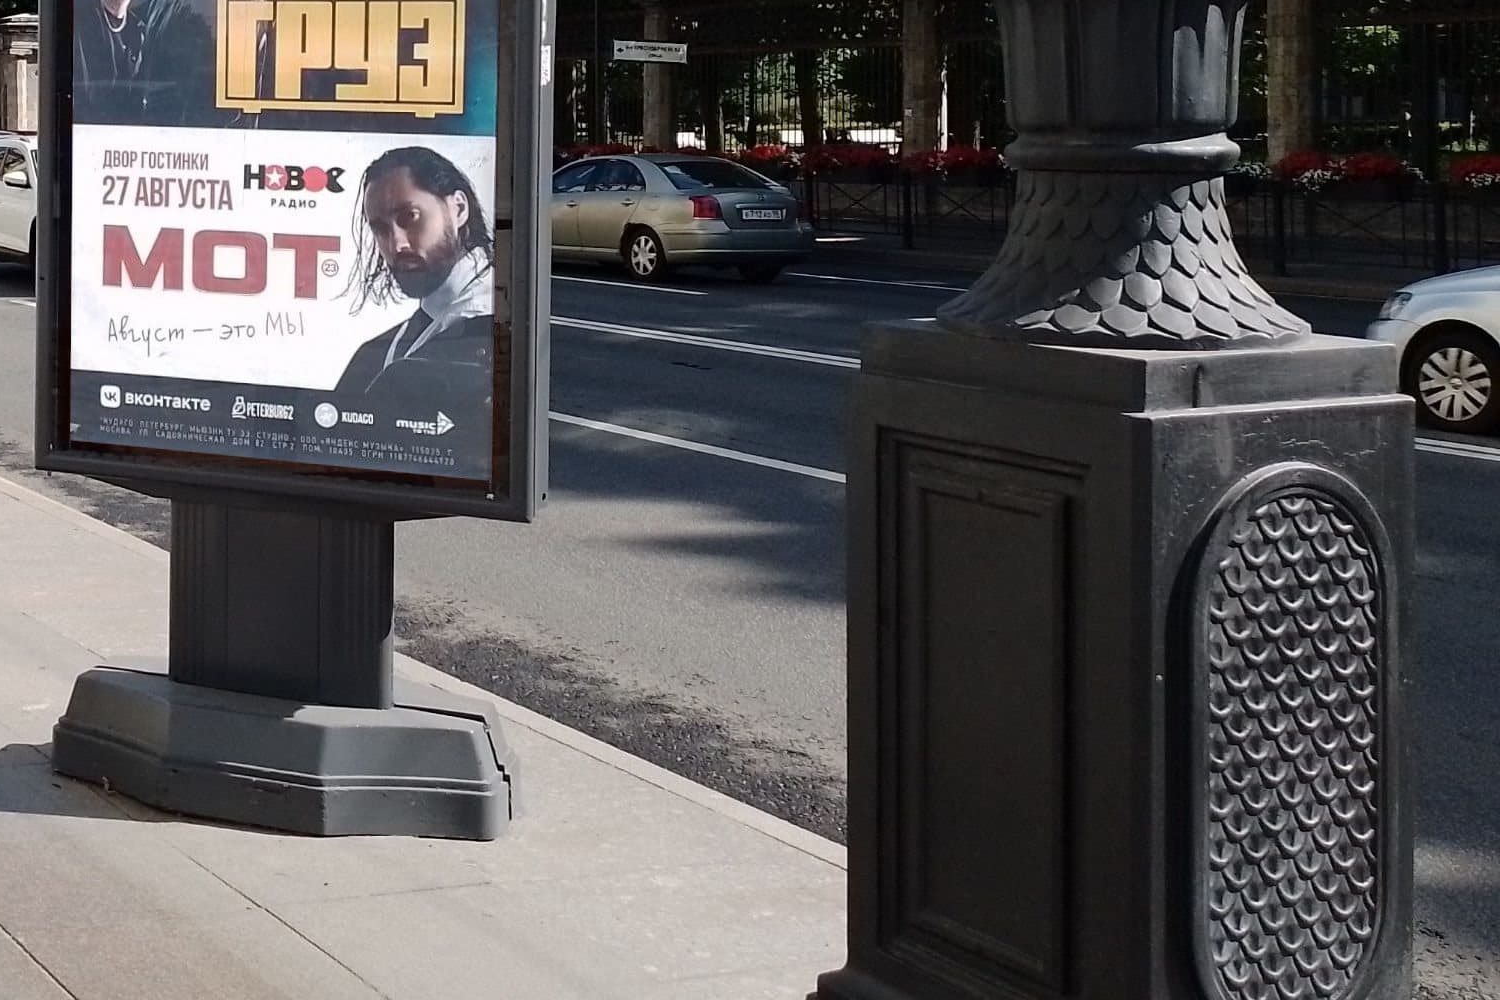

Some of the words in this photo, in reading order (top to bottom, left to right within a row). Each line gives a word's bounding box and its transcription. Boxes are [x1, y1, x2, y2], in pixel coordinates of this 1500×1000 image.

[226, 0, 456, 103] ГРУЗ
[103, 150, 137, 169] ДВОР
[141, 152, 209, 171] ГОСТИНКИ
[102, 175, 130, 206] 27
[134, 177, 233, 211] АВГУСТА
[270, 198, 317, 209] РАДИО
[102, 224, 341, 300] МОТ
[323, 262, 338, 274] 23
[108, 315, 185, 357] Август
[219, 323, 256, 340] это
[246, 402, 295, 421] PETERBURG2
